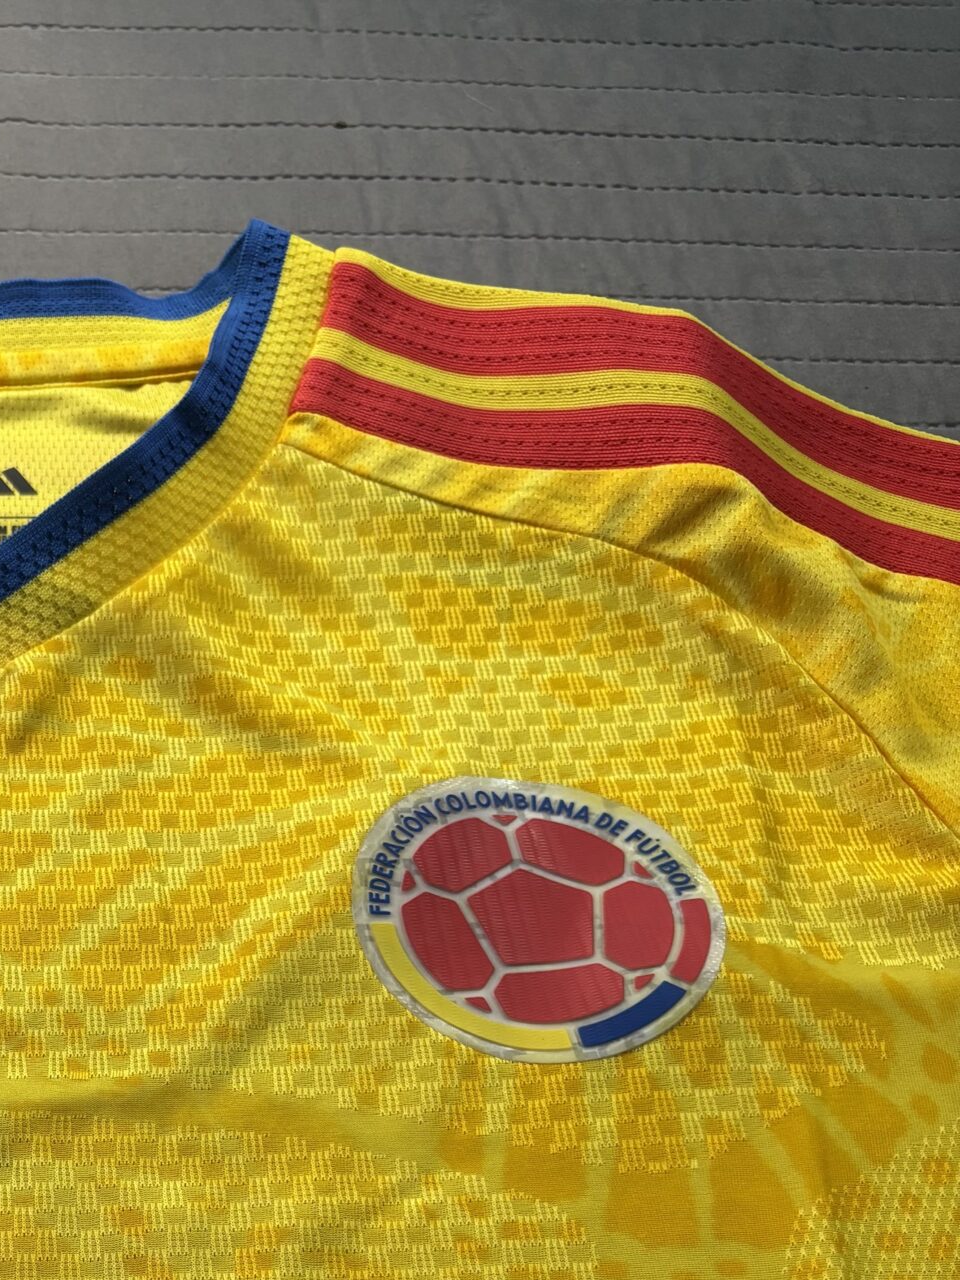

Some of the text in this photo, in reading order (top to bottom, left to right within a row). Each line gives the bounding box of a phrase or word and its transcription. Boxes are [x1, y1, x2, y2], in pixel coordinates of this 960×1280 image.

[368, 791, 697, 916] FEDERACIÓN COLOMBIANA DE FÚTBOL
